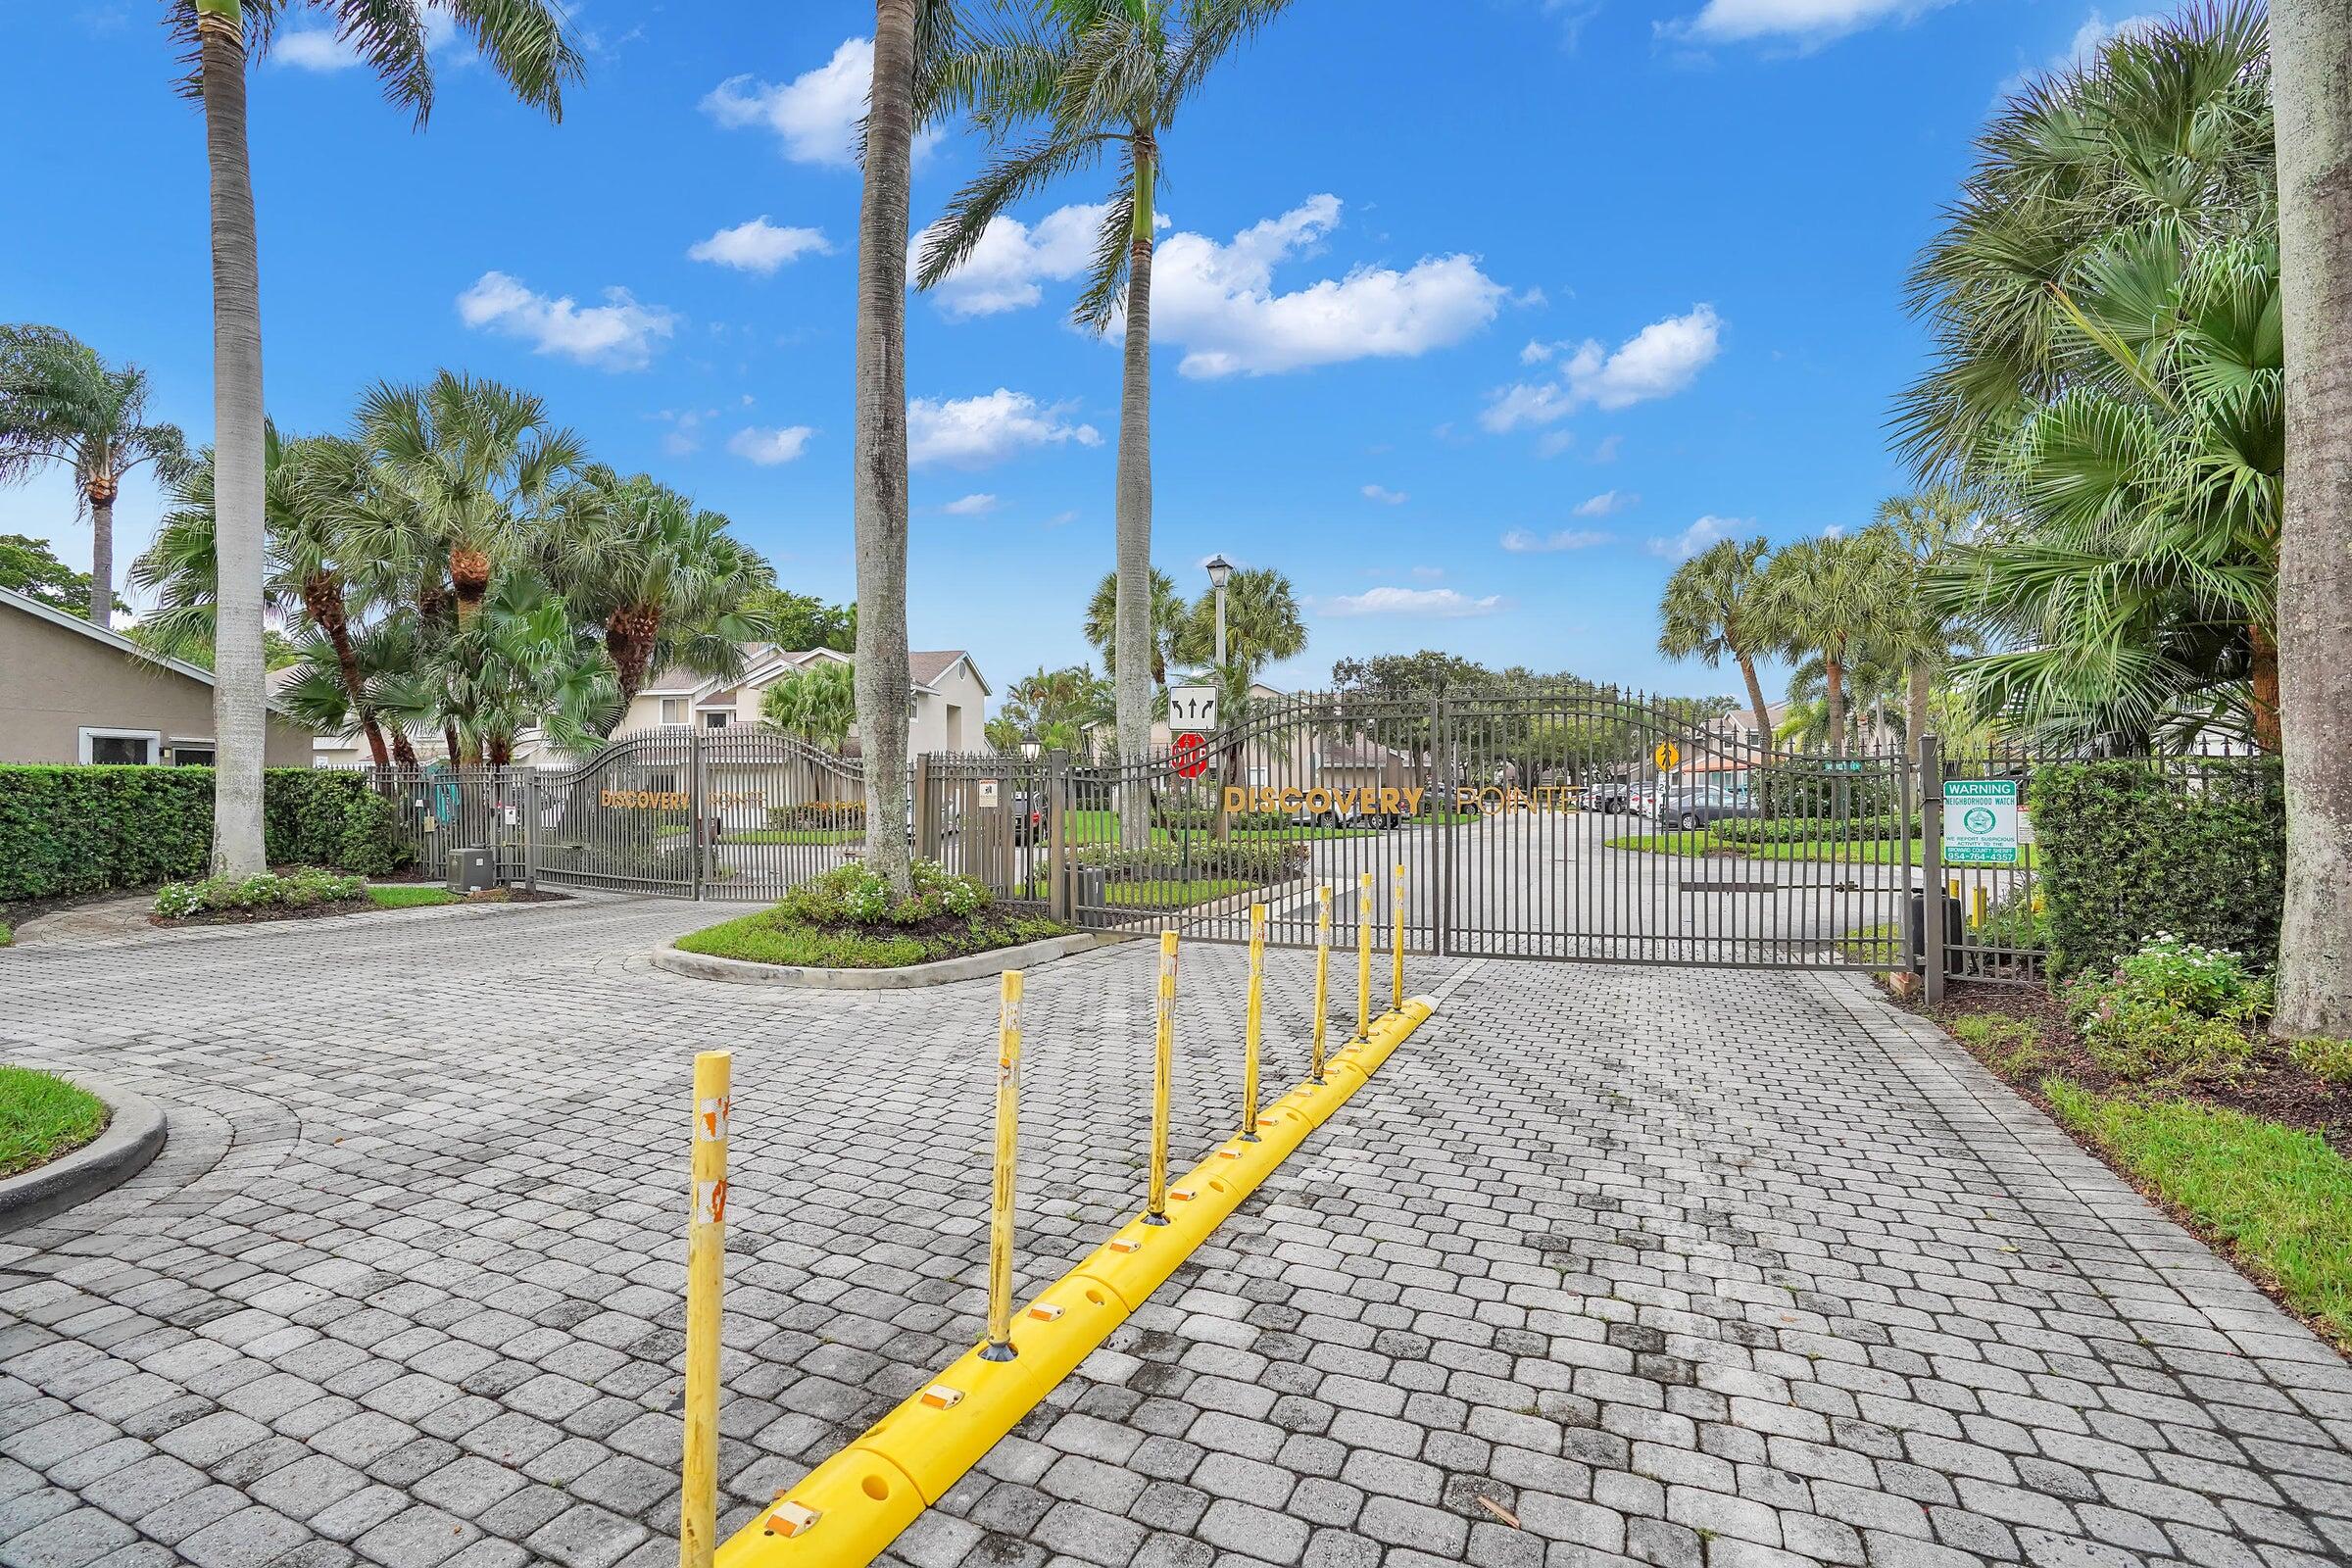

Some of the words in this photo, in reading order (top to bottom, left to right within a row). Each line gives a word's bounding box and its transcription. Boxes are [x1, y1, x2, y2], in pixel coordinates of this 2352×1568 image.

[1949, 784, 2011, 794] WARNING
[601, 790, 690, 810] DISCOVERY
[1223, 787, 1426, 814] DISCOVERY
[1456, 786, 1580, 815] POINTE
[1945, 797, 1992, 806] NEIGHBORHOOD
[1994, 797, 2015, 806] WATCH
